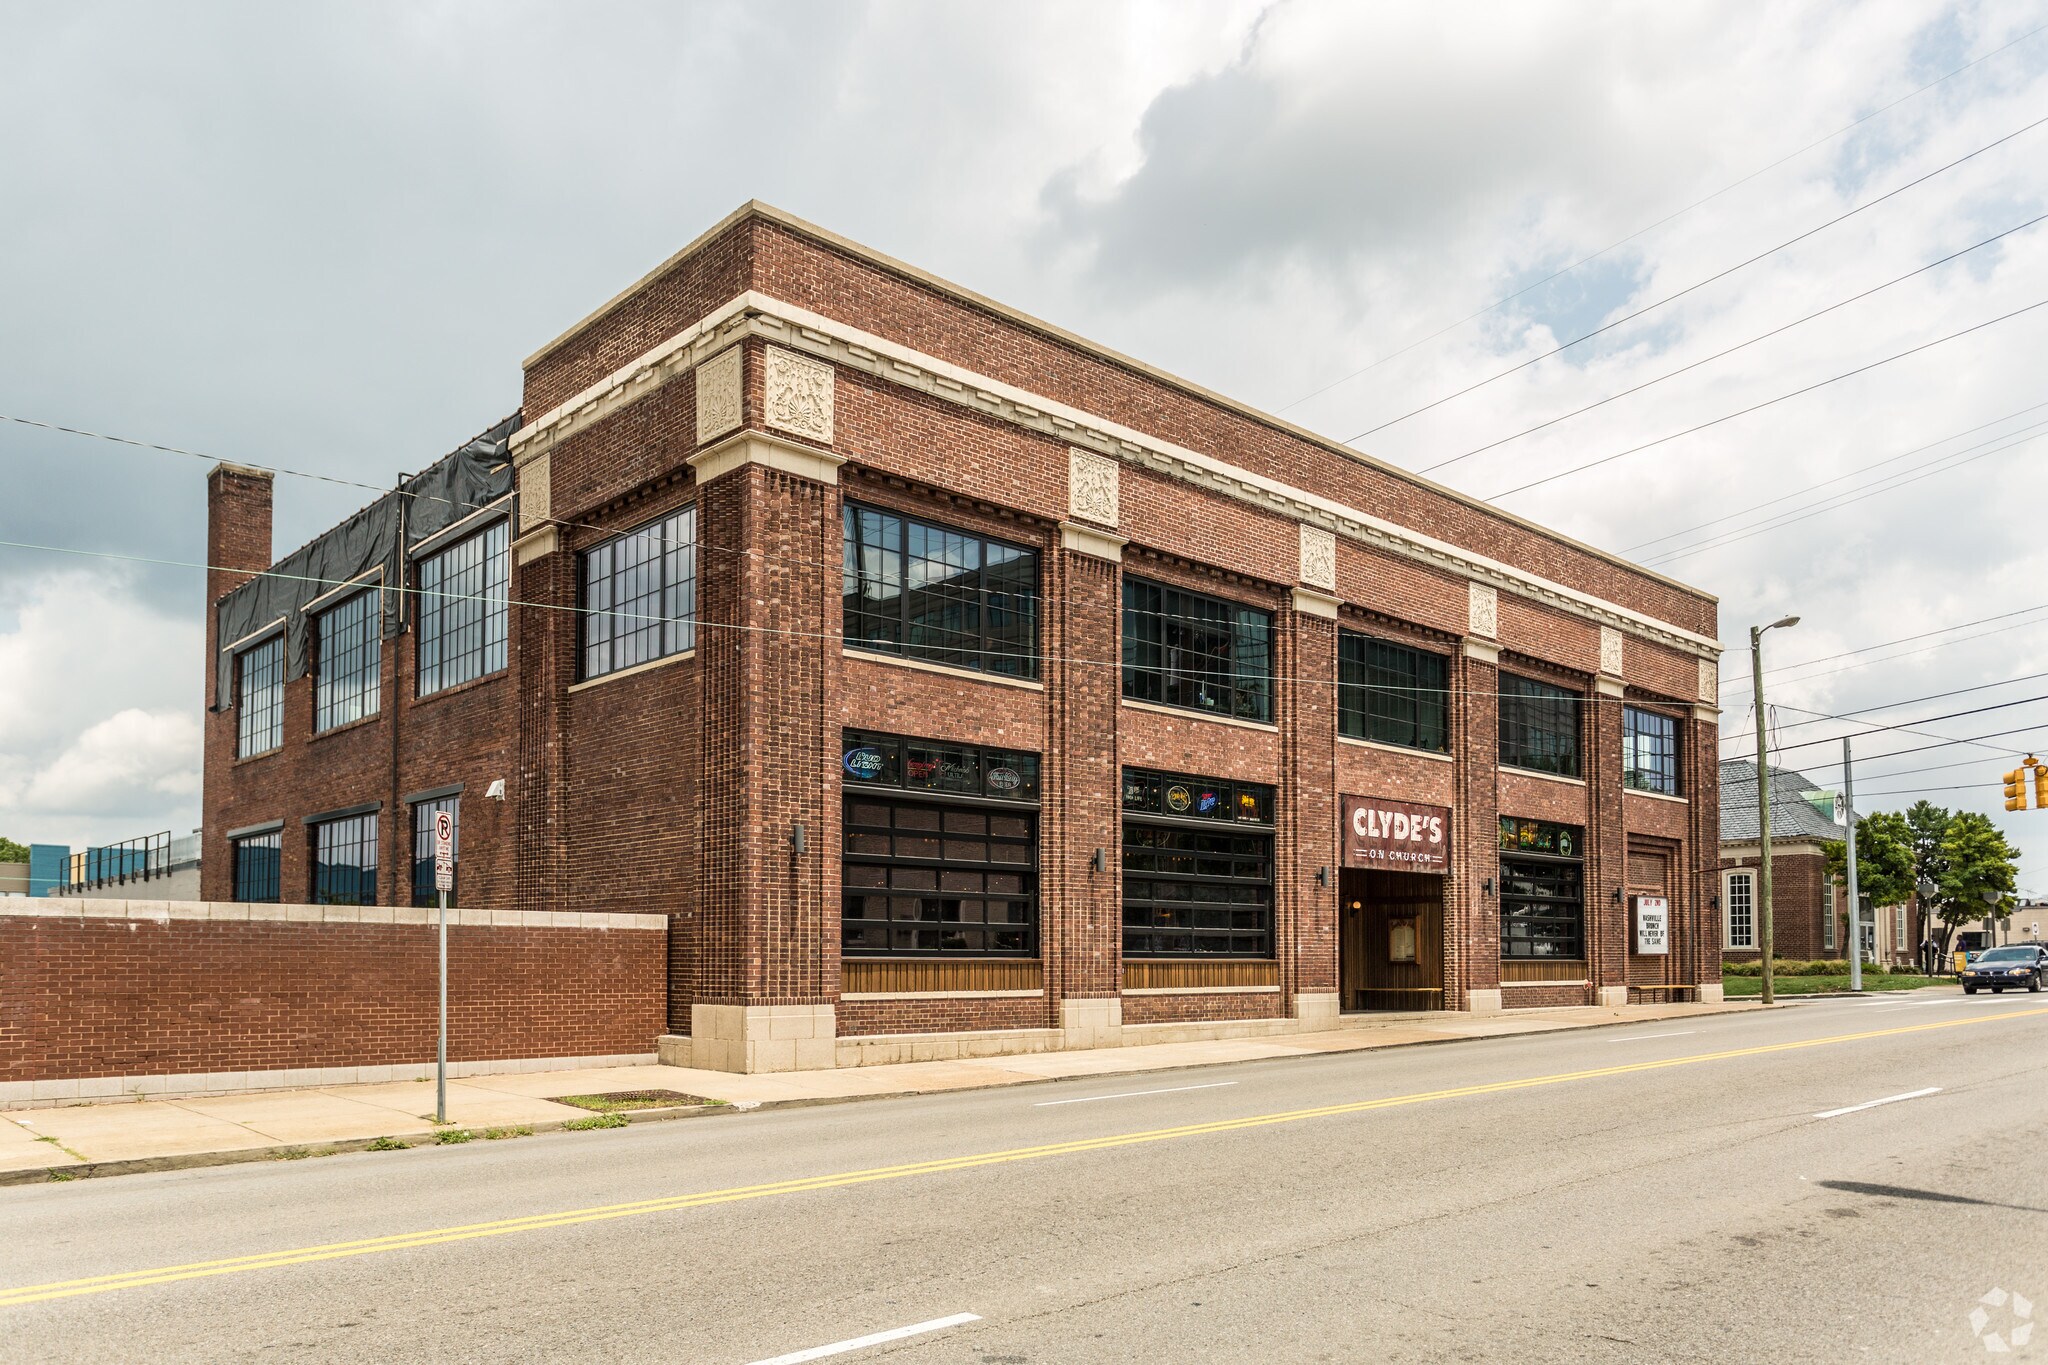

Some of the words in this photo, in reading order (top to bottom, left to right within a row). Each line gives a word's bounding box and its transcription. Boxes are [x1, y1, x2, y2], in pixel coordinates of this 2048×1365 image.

[907, 769, 929, 778] OPEN
[1353, 807, 1442, 843] CLYDE'S
[1369, 849, 1385, 859] ON
[1389, 850, 1431, 862] CHURCH
